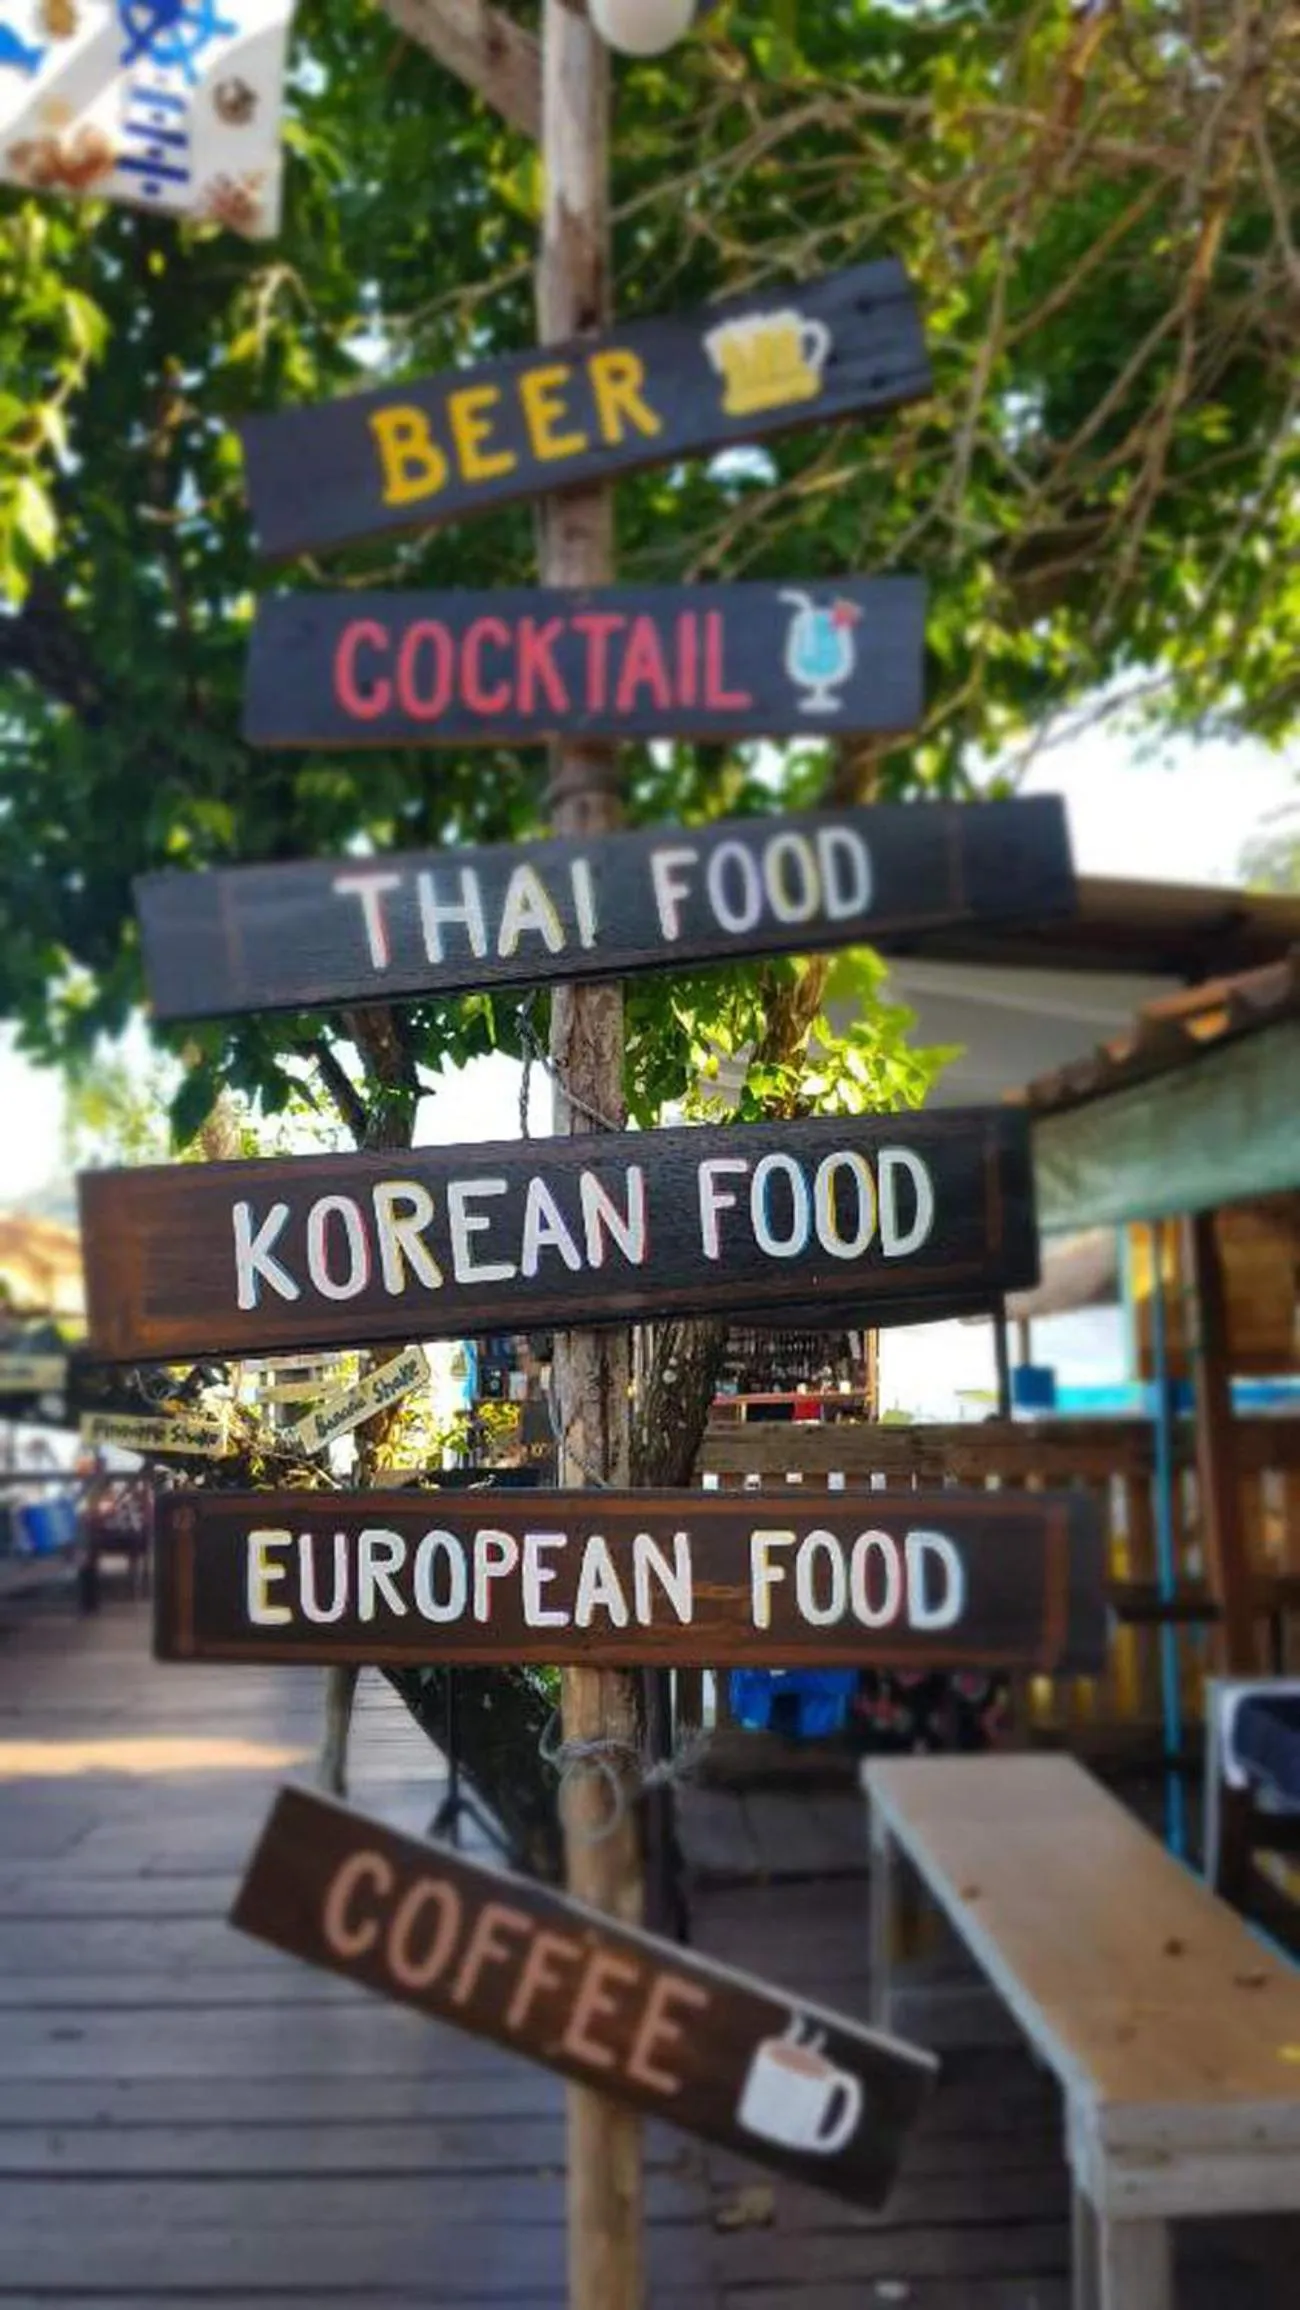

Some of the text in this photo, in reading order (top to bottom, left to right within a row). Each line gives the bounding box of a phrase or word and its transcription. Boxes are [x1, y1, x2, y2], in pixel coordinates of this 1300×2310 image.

[368, 348, 662, 505] BEER
[334, 611, 752, 721] COCKTAIL
[332, 826, 873, 969] THAI FOOD
[232, 1146, 934, 1310] KOREAN FOOD
[247, 1529, 965, 1632] EUROPEAN FOOD
[322, 1850, 709, 2094] COFFEE
